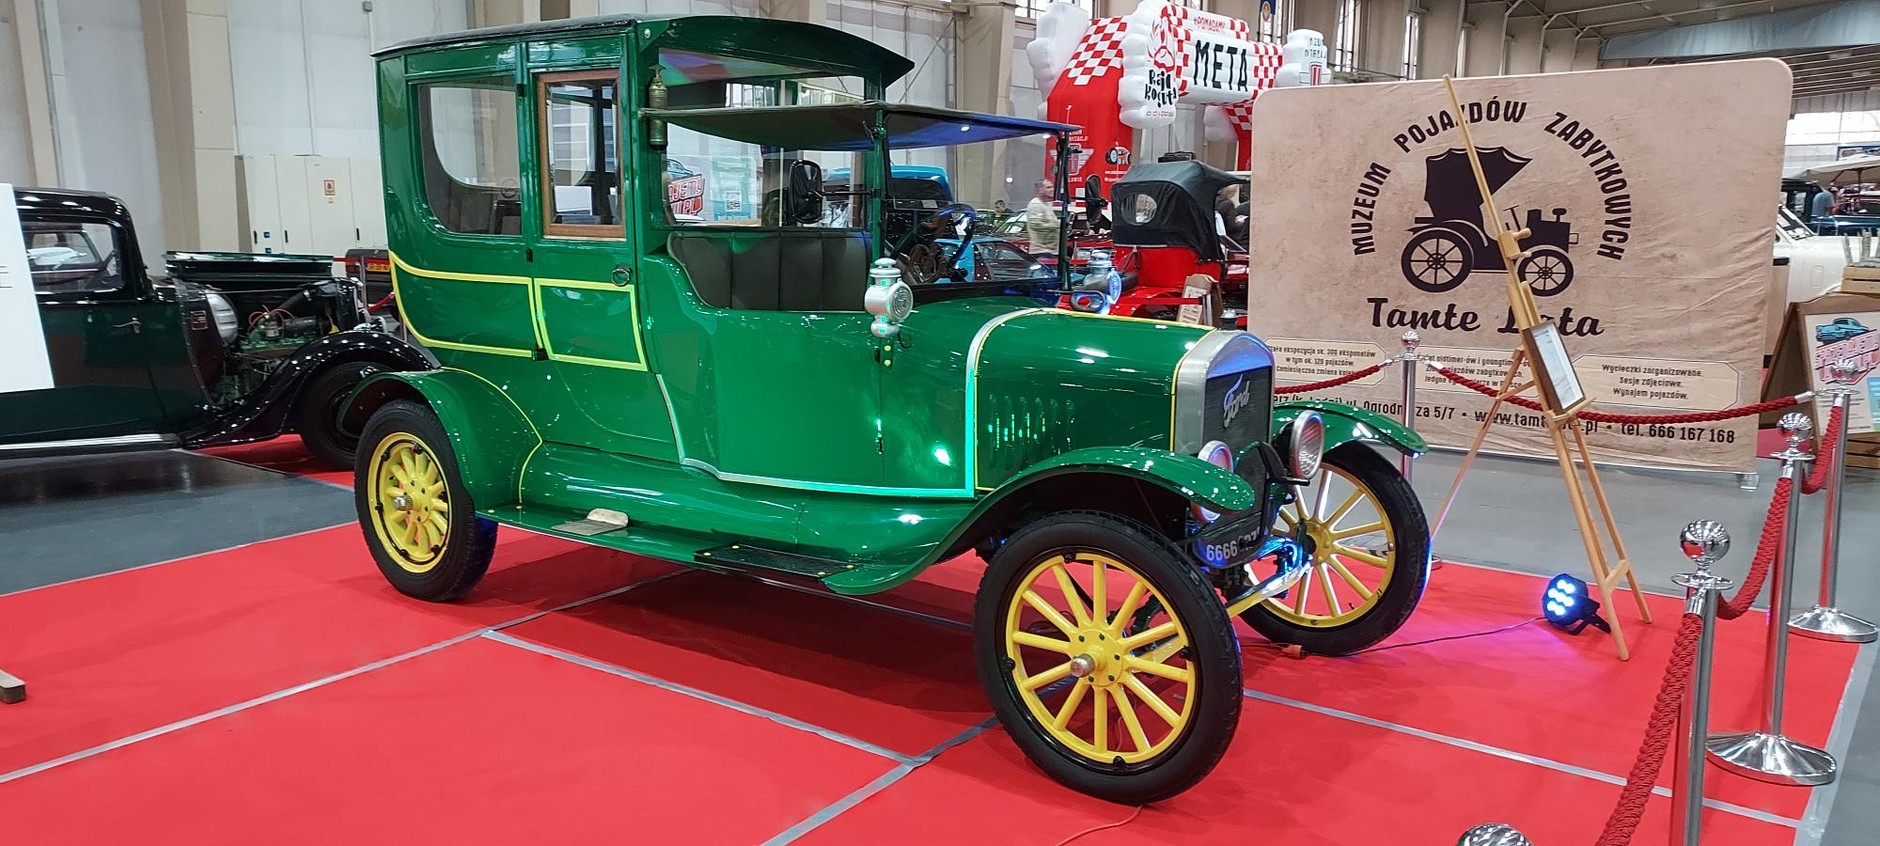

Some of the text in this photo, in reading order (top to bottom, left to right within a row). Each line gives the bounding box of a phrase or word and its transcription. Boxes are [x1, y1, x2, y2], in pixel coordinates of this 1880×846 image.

[1193, 40, 1248, 92] META
[1351, 96, 1632, 260] MUZEUM POJADÓW ZABYTKOWYCH
[1367, 297, 1605, 337] Tamte Lta
[1602, 363, 1641, 374] Wycieczki
[1619, 376, 1640, 388] Sesje
[1613, 387, 1648, 399] Wynajem
[1363, 400, 1430, 417] Ogrodnza
[1434, 406, 1455, 420] 5/7
[1649, 424, 1675, 439] 666
[1680, 426, 1704, 441] 167
[1709, 428, 1735, 443] 168
